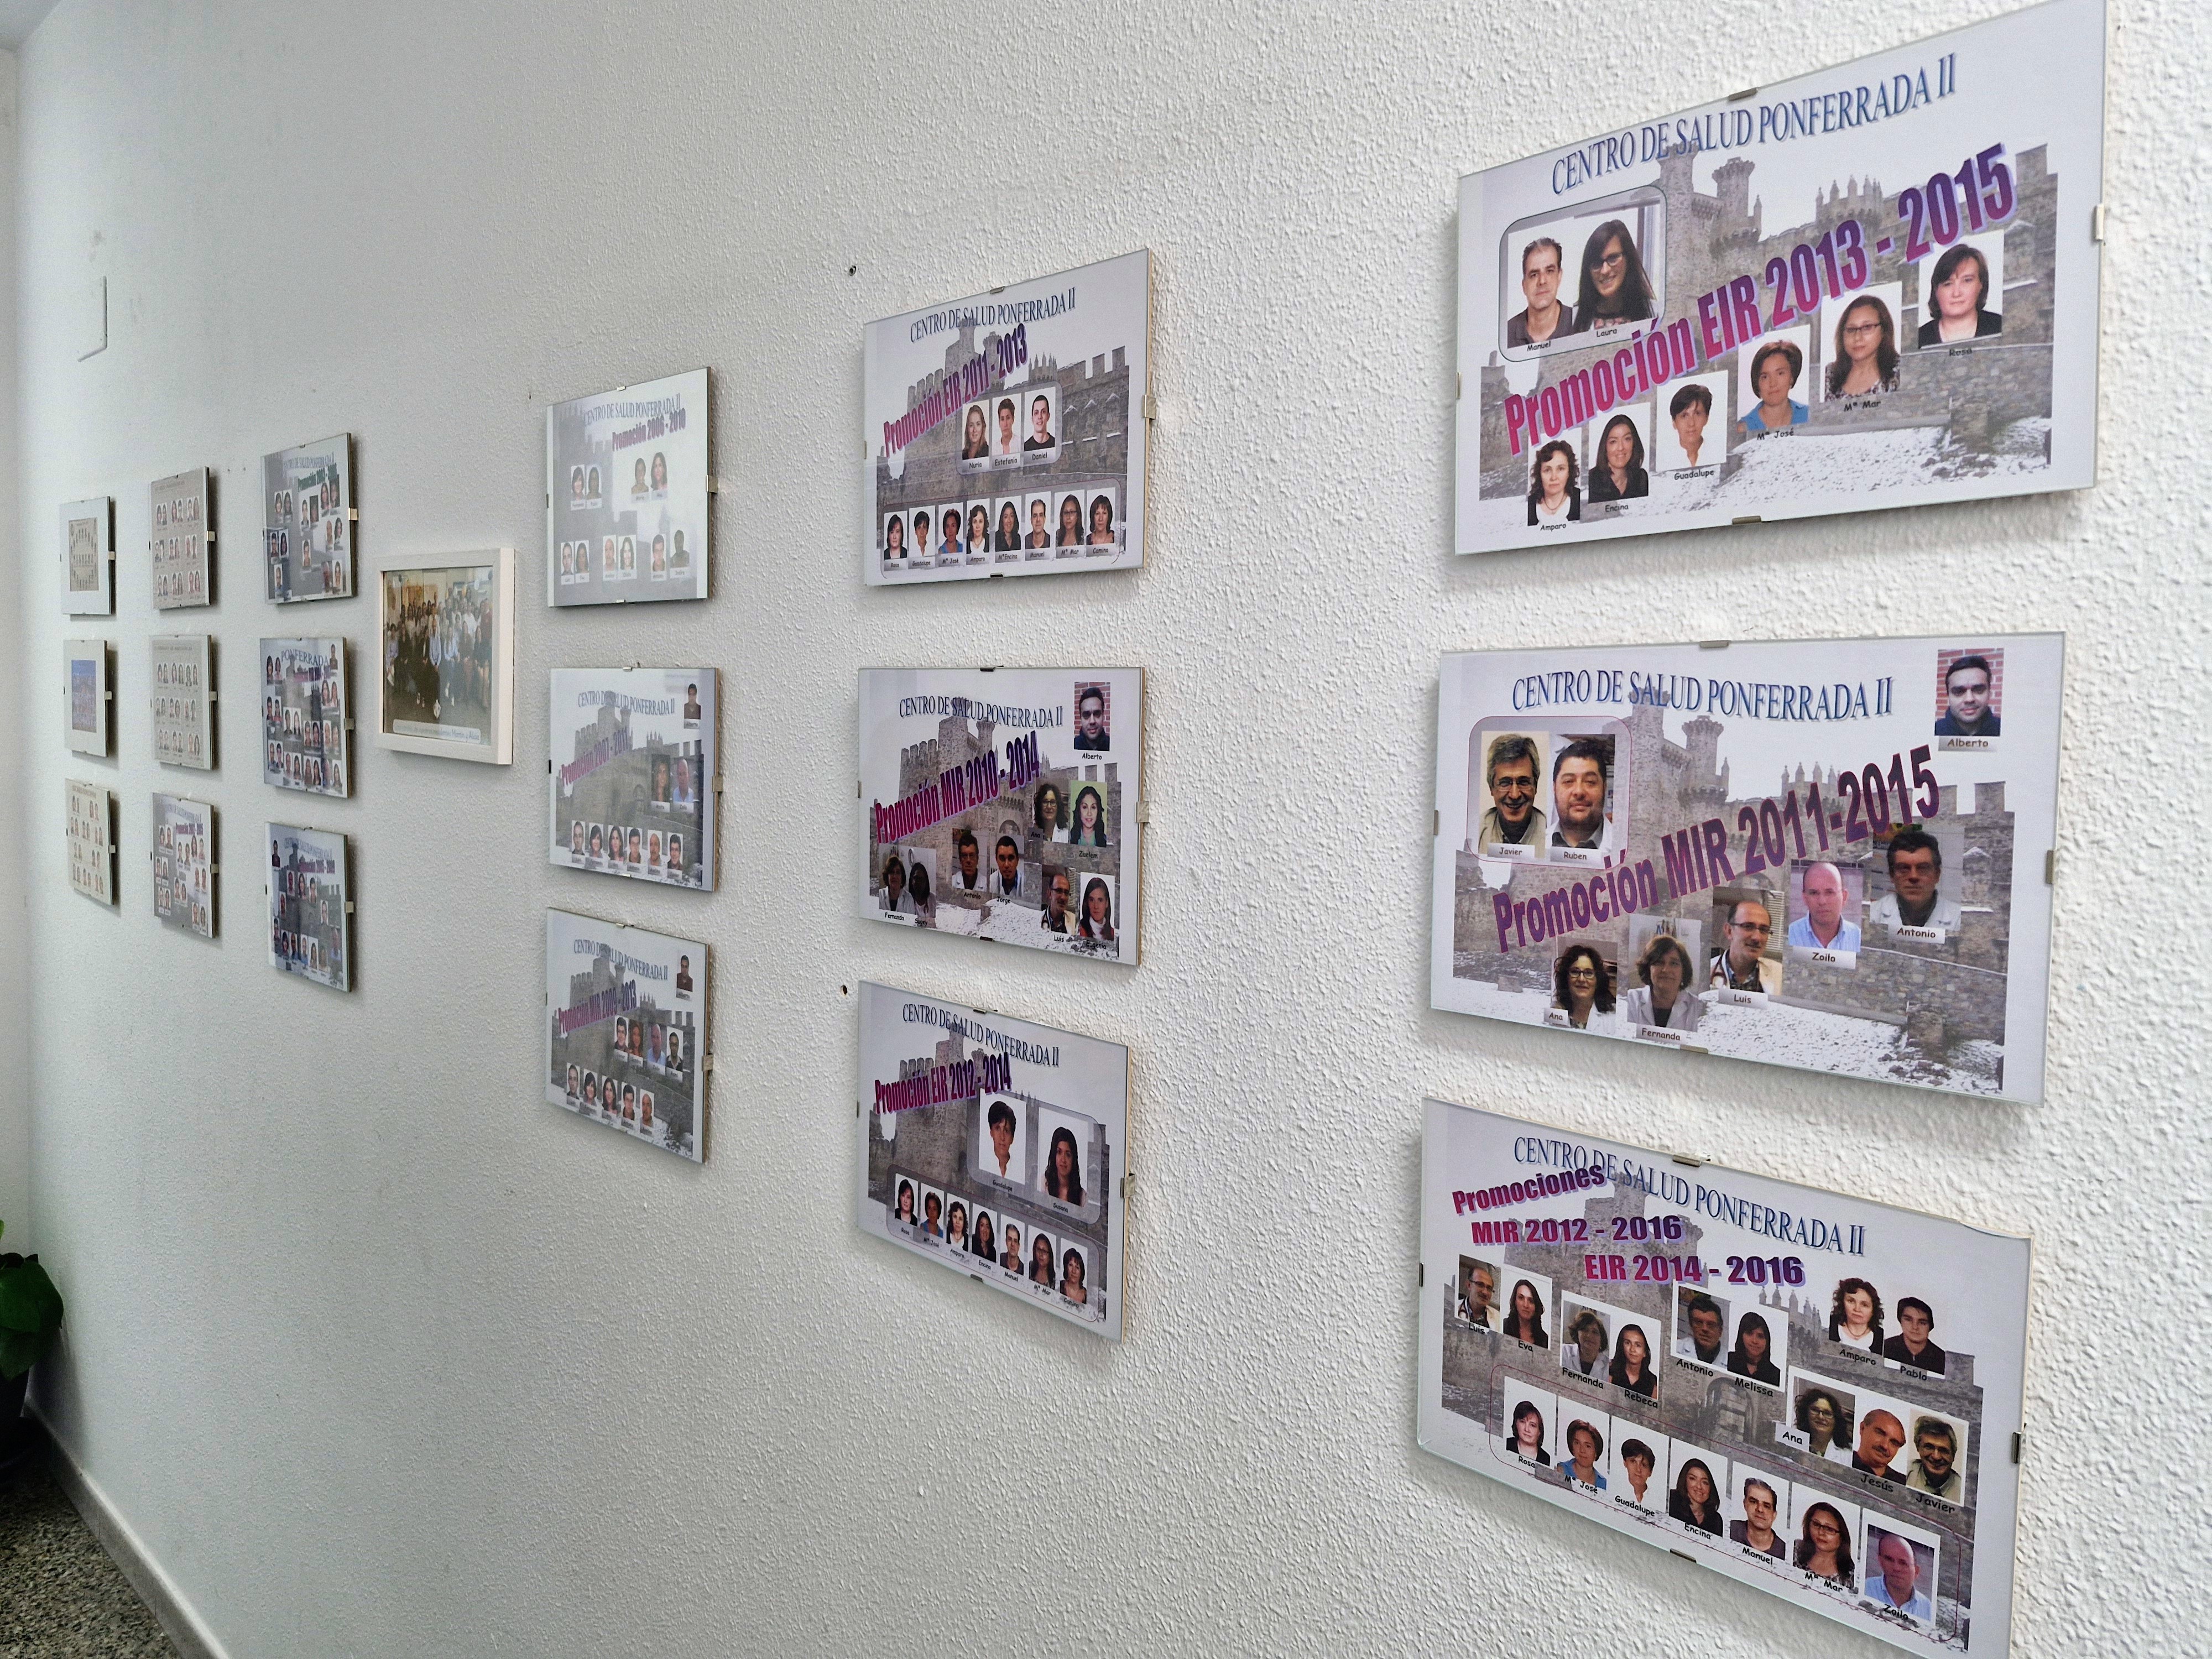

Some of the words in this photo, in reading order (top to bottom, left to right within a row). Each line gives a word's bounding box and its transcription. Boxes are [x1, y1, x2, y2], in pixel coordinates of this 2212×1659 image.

[1552, 132, 1635, 195] CENTRO
[1641, 123, 1670, 160] DE
[1676, 109, 1752, 153] SALUD
[1759, 67, 1932, 145] PONFERRADA
[1938, 53, 1957, 97] II
[1503, 313, 1699, 458] Promoción
[1697, 274, 1765, 362] EIR
[1765, 219, 1871, 328] 2013
[1898, 142, 2017, 264] 2015
[910, 311, 946, 343] CENTRO
[948, 308, 961, 329] DE
[963, 305, 995, 327] SALUD
[998, 293, 1066, 325] PONFERRADA
[1068, 286, 1076, 311] II
[1596, 328, 1618, 338] Laura
[1527, 341, 1551, 351] Manuel
[1949, 347, 1973, 357] Rosa
[883, 388, 943, 458] Promoción
[943, 372, 962, 418] EIR
[962, 350, 990, 403] 2011
[997, 323, 1029, 379] 2013
[615, 402, 634, 419] SALUD
[636, 397, 675, 418] PONFERRADA
[1862, 399, 1881, 409] Mar
[612, 422, 646, 451] Promoción
[669, 407, 686, 434] 2010
[1773, 428, 1794, 439] José
[1674, 469, 1714, 481] Guadalupe
[1605, 504, 1629, 513] Encina
[1540, 522, 1567, 532] Amparo
[281, 649, 329, 666] PONFERRADA
[578, 691, 600, 707] CENTRO
[630, 696, 670, 716] PONFERRADA
[1512, 670, 1591, 711] CENTRO
[1595, 670, 1624, 703] DE
[1628, 671, 1702, 711] SALUD
[1708, 678, 1869, 721] PONFERRADA
[1875, 676, 1893, 716] II
[899, 696, 935, 718] CENTRO
[937, 696, 950, 716] DE
[952, 697, 984, 721] SALUD
[987, 703, 1054, 729] PONFERRADA
[1056, 705, 1063, 727] II
[1947, 737, 1989, 748] Alberto
[875, 779, 941, 844] Promoción
[940, 765, 967, 818] MIR
[966, 750, 998, 808] 2010
[1006, 730, 1040, 791] 2014
[1493, 849, 1659, 953] Promoción
[1661, 818, 1736, 900] MIR
[1738, 744, 1940, 876] 2011-2015
[1499, 847, 1522, 855] Javier
[1563, 851, 1587, 860] Ruben
[964, 891, 981, 900] Antonio
[997, 896, 1011, 905] Jorge
[885, 912, 904, 922] Fernanda
[1053, 935, 1065, 943] Luis
[1897, 927, 1936, 939] Antonio
[1086, 940, 1107, 951] Eugenia
[574, 940, 595, 955] CENTRO
[624, 954, 662, 980] PONFERRADA
[1812, 952, 1836, 963] Zoilo
[1734, 994, 1751, 1004] Luis
[1548, 1011, 1563, 1021] Ana
[903, 1004, 937, 1025] CENTRO
[940, 1009, 952, 1029] DE
[952, 1015, 983, 1042] SALUD
[985, 1027, 1051, 1066] PONFERRADA
[1052, 1046, 1060, 1068] II
[1641, 1028, 1681, 1041] Fernanda
[875, 1069, 930, 1115] Promoción
[930, 1065, 949, 1105] EIR
[949, 1059, 976, 1100] 2012
[983, 1051, 1012, 1095] 2014
[1452, 1165, 1606, 1215] Promociones
[1514, 1136, 1587, 1170] CENTRO
[1593, 1149, 1618, 1182] DE
[1623, 1159, 1689, 1206] SALUD
[1696, 1188, 1844, 1254] PONFERRADA
[1849, 1224, 1865, 1256] II
[1472, 1220, 1519, 1245] MIR
[1525, 1218, 1589, 1244] 2012
[1611, 1214, 1684, 1243] 2016
[978, 1259, 992, 1270] Encina
[1584, 1255, 1629, 1282] EIR
[1633, 1255, 1704, 1283] 2014
[1726, 1256, 1805, 1285] 2016
[1004, 1271, 1019, 1282] Manuel
[1468, 1323, 1485, 1334] Luis
[1518, 1340, 1533, 1353] Eva
[1839, 1348, 1876, 1366] Amparo
[1676, 1358, 1714, 1378] Antonio
[1900, 1365, 1928, 1381] Pablo
[1562, 1366, 1604, 1389] Fernanda
[1735, 1377, 1773, 1398] Melissa
[1624, 1389, 1658, 1408] Rebeca
[1782, 1431, 1803, 1445] Ana
[1518, 1455, 1535, 1468] Rosa
[1580, 1481, 1598, 1495] José
[1861, 1474, 1894, 1493] Jesús
[1615, 1495, 1655, 1517] Guadalupe
[1916, 1493, 1955, 1515] Javier
[1684, 1522, 1712, 1540] Encina
[1742, 1547, 1773, 1565] Manuel
[1824, 1579, 1844, 1593] Mar
[1884, 1603, 1910, 1621] Zoilo
